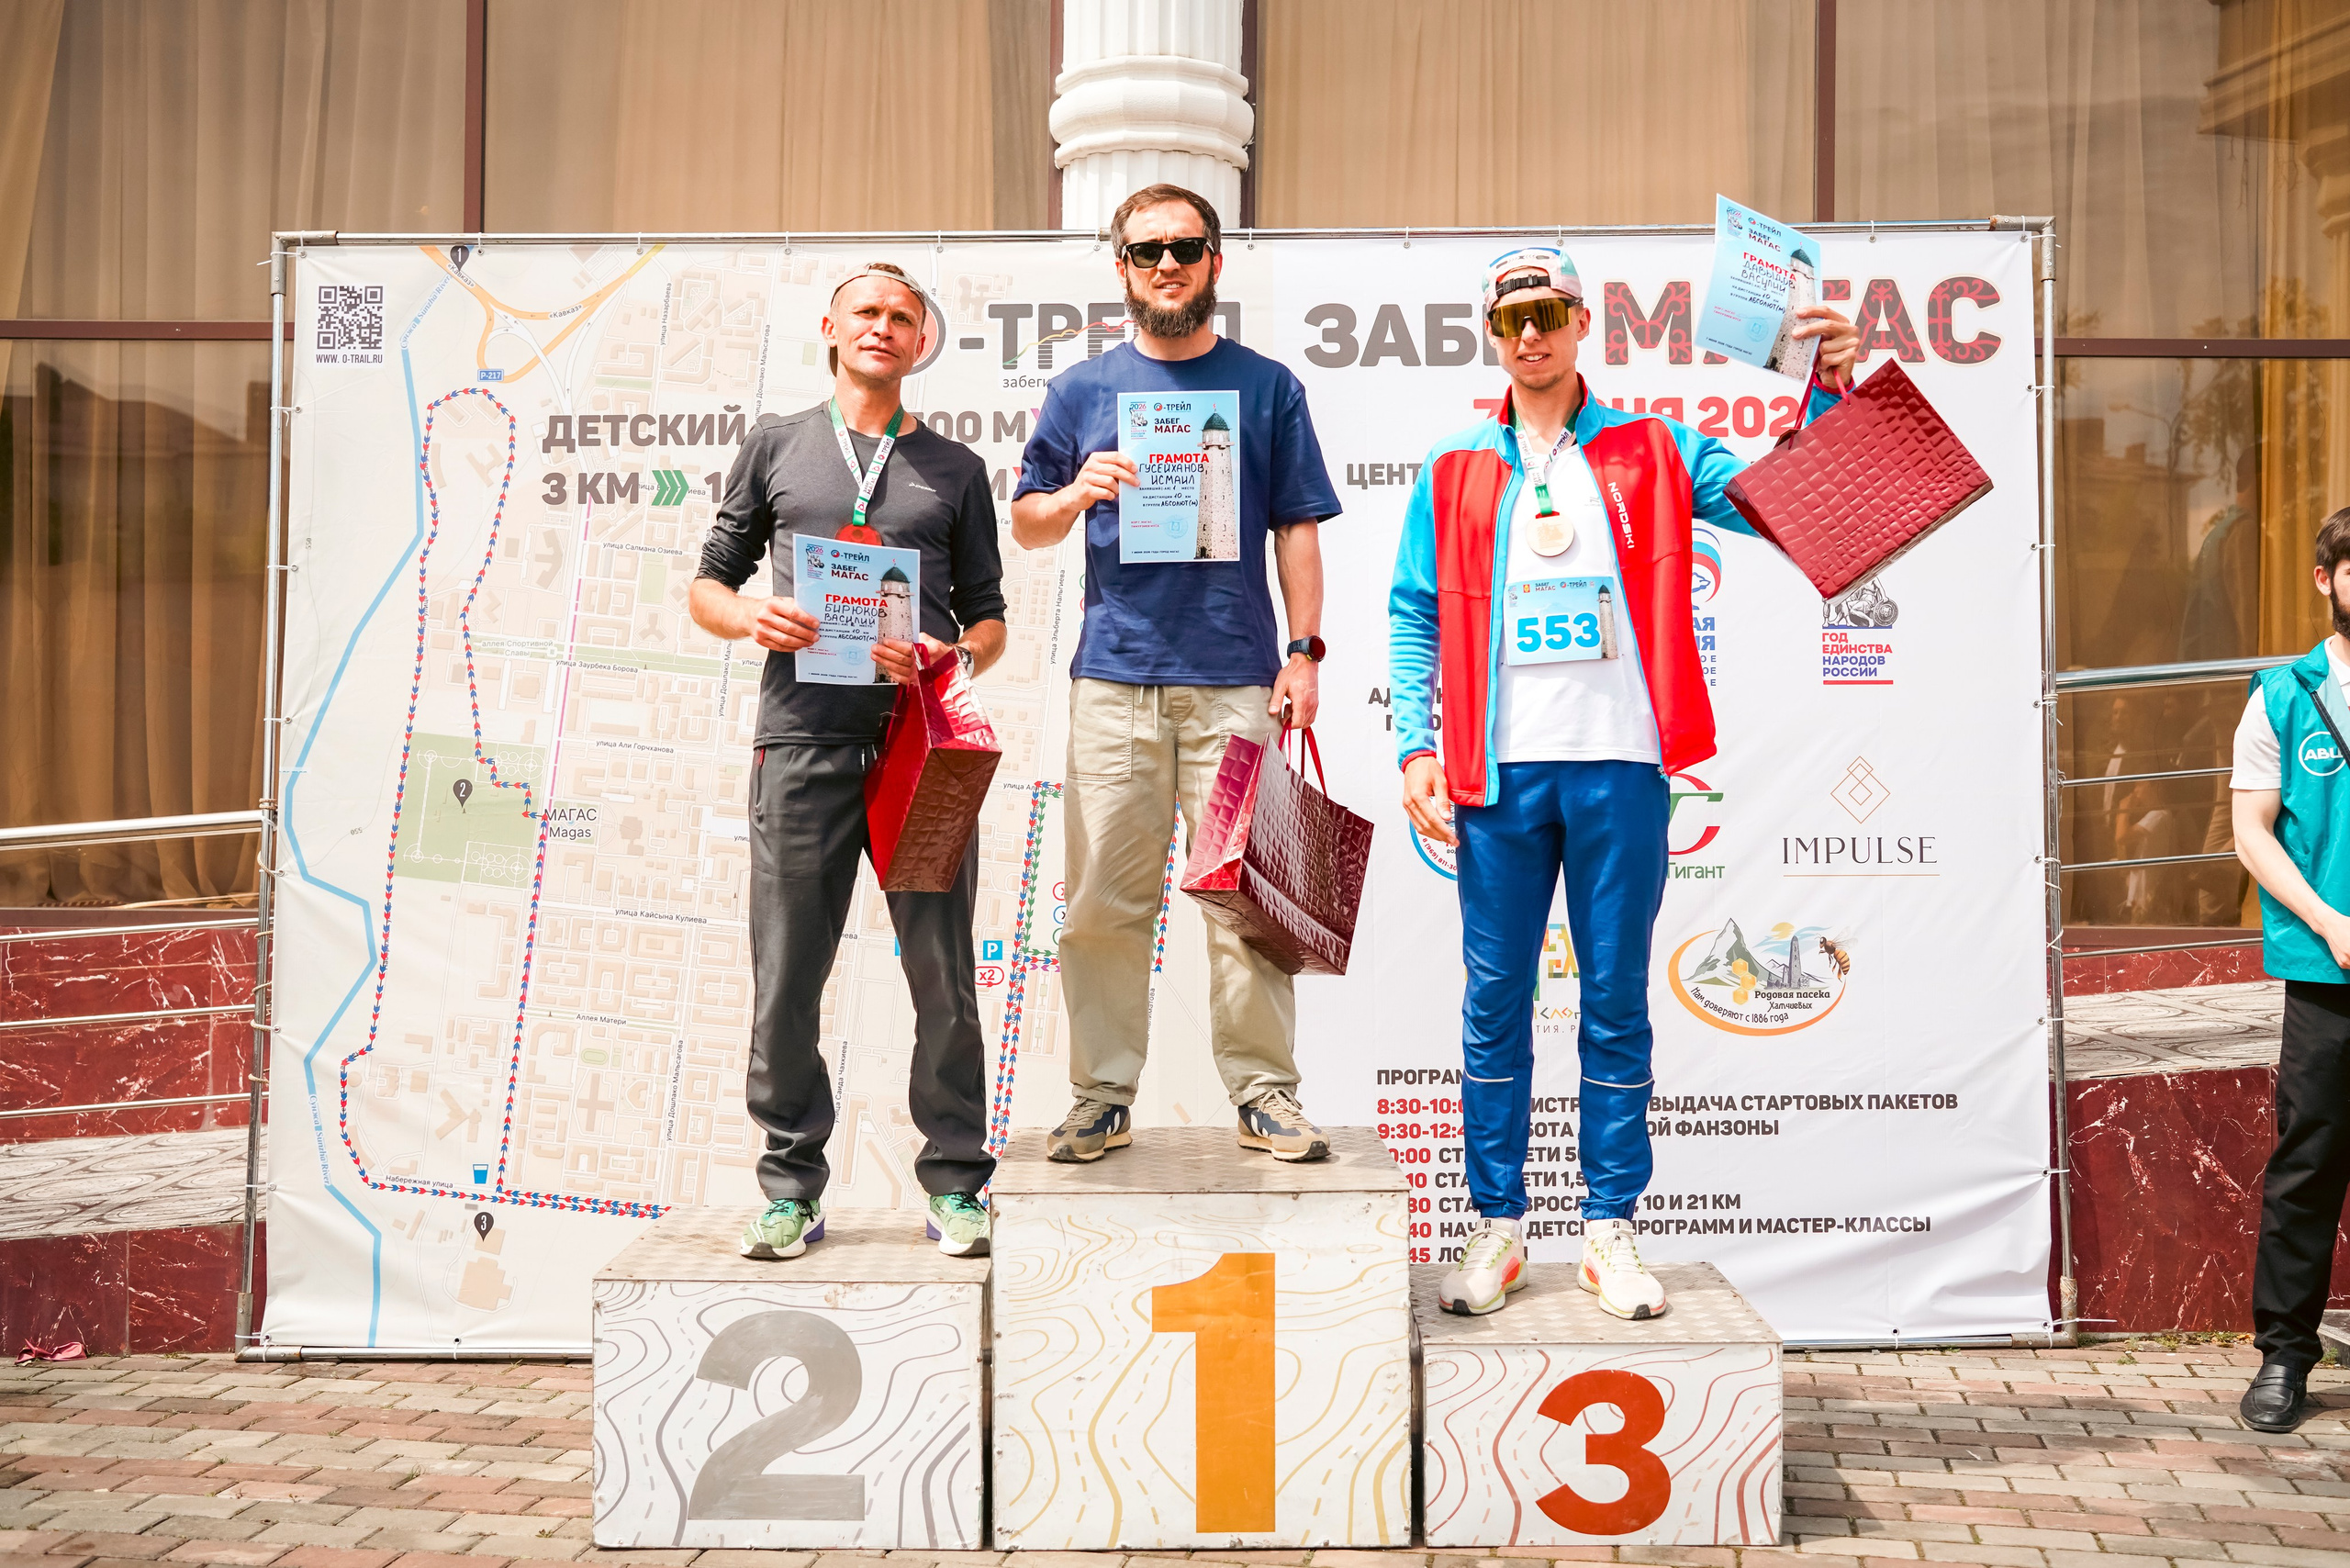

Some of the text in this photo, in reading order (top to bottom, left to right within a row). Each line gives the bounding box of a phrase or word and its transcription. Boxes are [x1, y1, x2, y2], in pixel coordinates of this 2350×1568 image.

[1749, 233, 1781, 252] МАГАС
[1743, 252, 1796, 282] ГРАМОТА
[662, 283, 672, 324] Назарбаева
[760, 324, 770, 364] Мальсагова
[1698, 396, 1800, 438] 202
[542, 404, 745, 454] ДЕТСКИЙ
[1155, 424, 1191, 433] МАГАС
[1149, 454, 1209, 464] ГРАМОТА
[1346, 463, 1423, 489] ЦЕНТ
[577, 472, 639, 504] КМ
[1607, 482, 1635, 549] NORDSKI
[603, 542, 683, 555] улица Салмана Озиева
[831, 564, 857, 572] ЗАБЕГ
[831, 570, 869, 581] МАГАС
[826, 594, 888, 607] ГРАМОТА
[1516, 612, 1601, 653] 553
[1822, 633, 1848, 644] ГОД
[507, 640, 553, 648] Спортивной
[1822, 644, 1893, 655] ЕДИНСТВА
[556, 659, 638, 673] улица Заурбека Борова
[1822, 655, 1886, 666] НАРОДОВ
[721, 663, 730, 695] Дошлако
[1823, 667, 1877, 677] РОССИИ
[597, 740, 674, 754] улица Али Горчханова
[544, 809, 597, 822] МАГАС
[549, 827, 592, 840] Magas
[1783, 836, 1938, 864] IMPULSE
[615, 909, 707, 924] улица Кайсына Кулиева
[987, 943, 999, 958] P
[1690, 986, 1706, 1003] Нам
[1704, 1000, 1744, 1021] доверяют
[1751, 1014, 1769, 1024] 1886
[1770, 1012, 1789, 1024] года
[1754, 991, 1830, 1001] Родовая пасека
[576, 1014, 627, 1026] Аллея Матери
[837, 1041, 848, 1078] Чахкиева
[668, 1085, 678, 1118] Дошлако
[673, 1040, 684, 1084] Мальсагова
[835, 1079, 845, 1103] Саида
[1649, 1095, 1738, 1114] ВЫДАЧА
[1740, 1094, 1864, 1112] СТАРТОВЫХ
[1867, 1093, 1958, 1111] ПАКЕТОВ
[1675, 1119, 1779, 1137] ФАНЗОНЫ
[1525, 1147, 1561, 1162] ЕТИ
[321, 1162, 330, 1184] River
[386, 1175, 431, 1186] Набережная
[1522, 1171, 1557, 1187] ЕТИ
[1643, 1194, 1664, 1211] 10
[1669, 1194, 1683, 1210] И
[1686, 1194, 1707, 1210] 21
[1712, 1193, 1741, 1209] КМ
[1739, 1218, 1752, 1234] И
[1757, 1216, 1931, 1234] МАСТЕР-КЛАССЫ
[1151, 1252, 1276, 1533] 1
[688, 1309, 865, 1521] 2
[1535, 1368, 1672, 1535] 3
